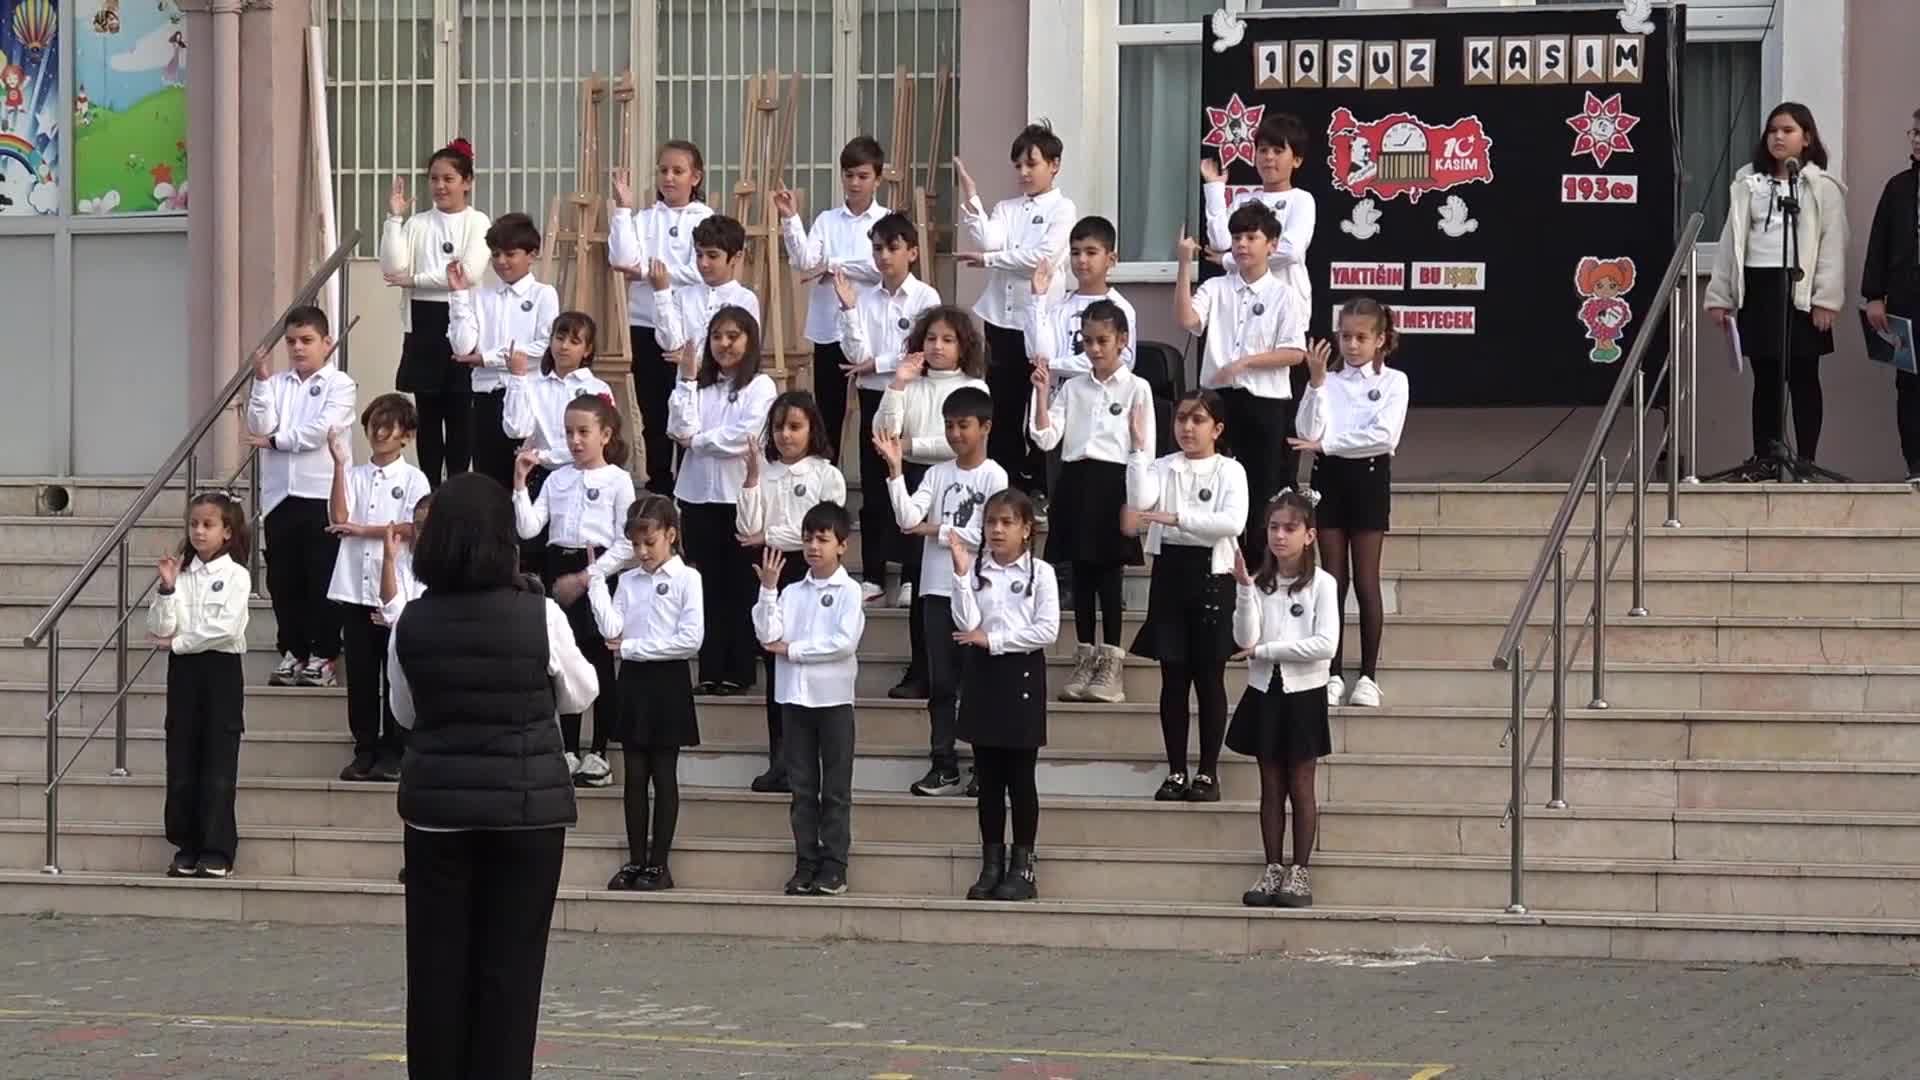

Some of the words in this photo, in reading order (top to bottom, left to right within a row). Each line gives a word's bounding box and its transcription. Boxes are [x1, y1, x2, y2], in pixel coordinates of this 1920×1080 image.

[1471, 44, 1638, 70] KASIM
[1435, 158, 1478, 171] KASIM
[1332, 263, 1403, 285] YAKTIĞIN
[1420, 267, 1441, 285] BU
